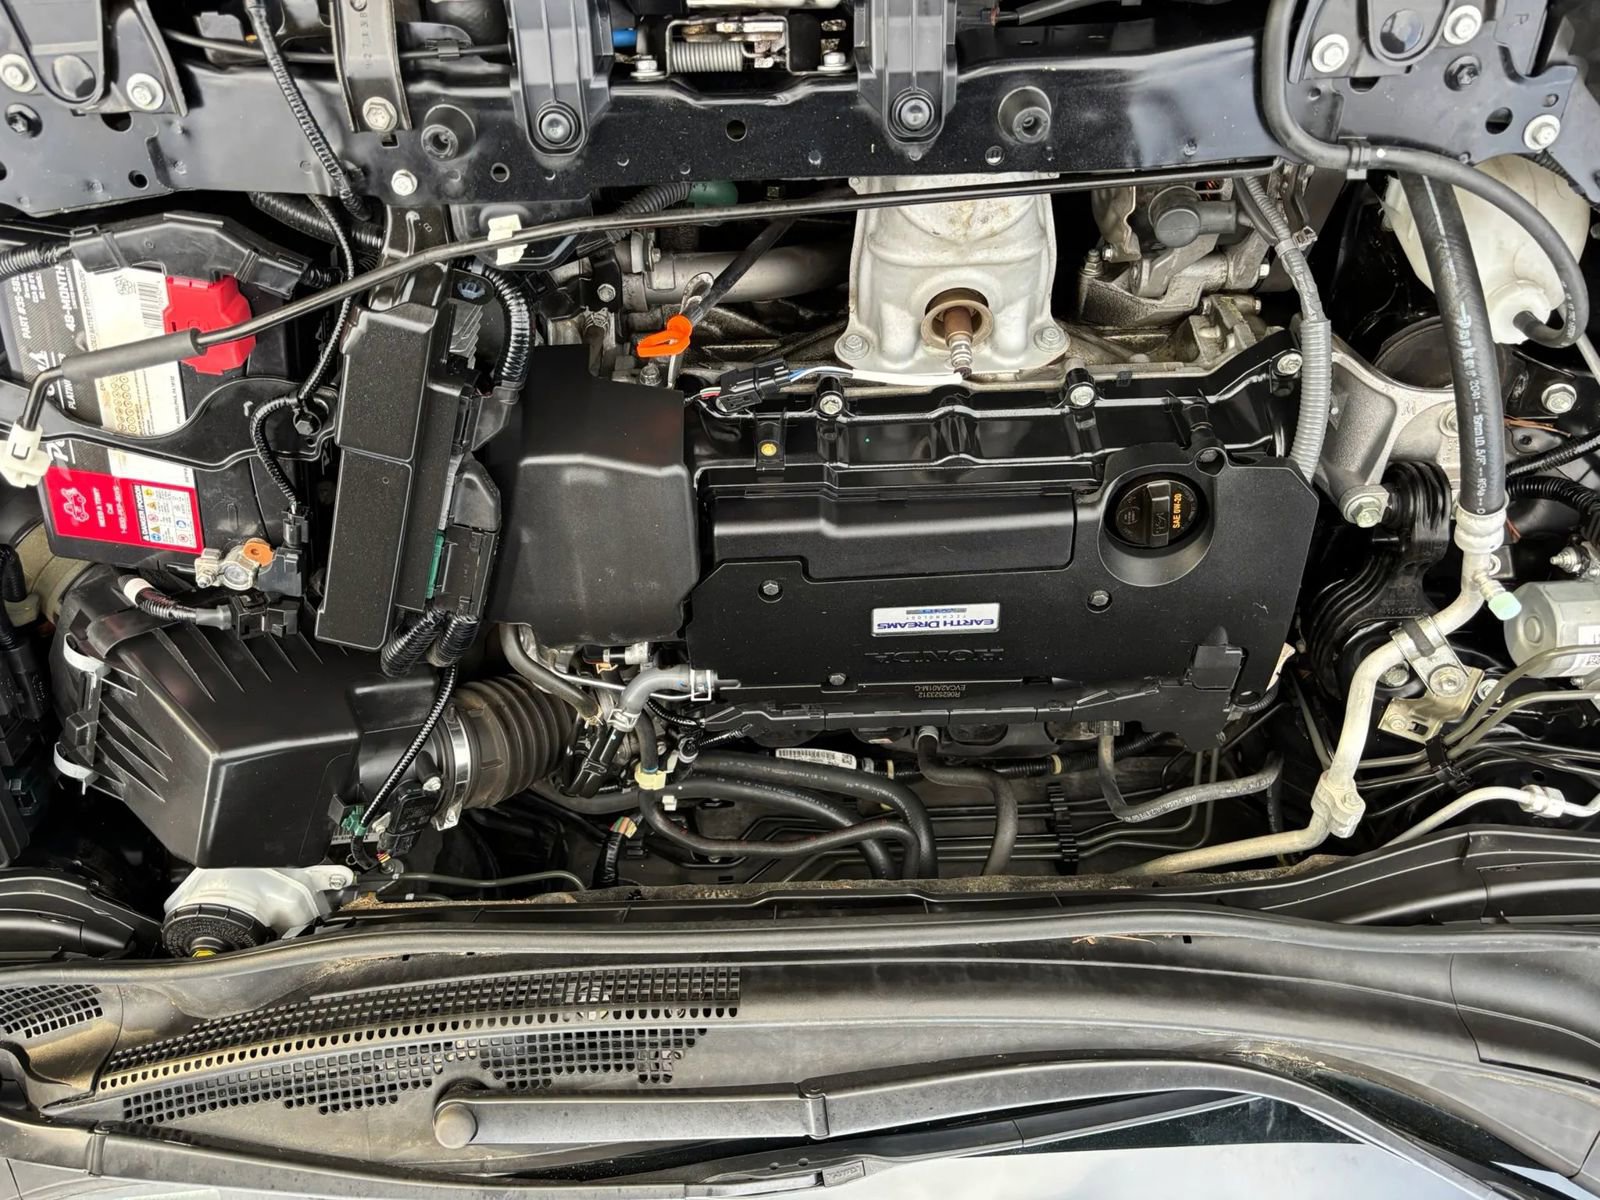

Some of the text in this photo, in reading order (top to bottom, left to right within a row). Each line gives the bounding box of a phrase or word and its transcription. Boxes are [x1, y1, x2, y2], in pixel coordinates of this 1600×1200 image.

[56, 265, 76, 332] 48-MONTH
[19, 314, 31, 339] PART
[1457, 315, 1476, 377] Parker
[63, 379, 76, 410] PLATIN
[1172, 494, 1182, 528] SAE 0W-20
[876, 618, 994, 630] EARTH DREAMS
[864, 648, 1004, 664] HONDA
